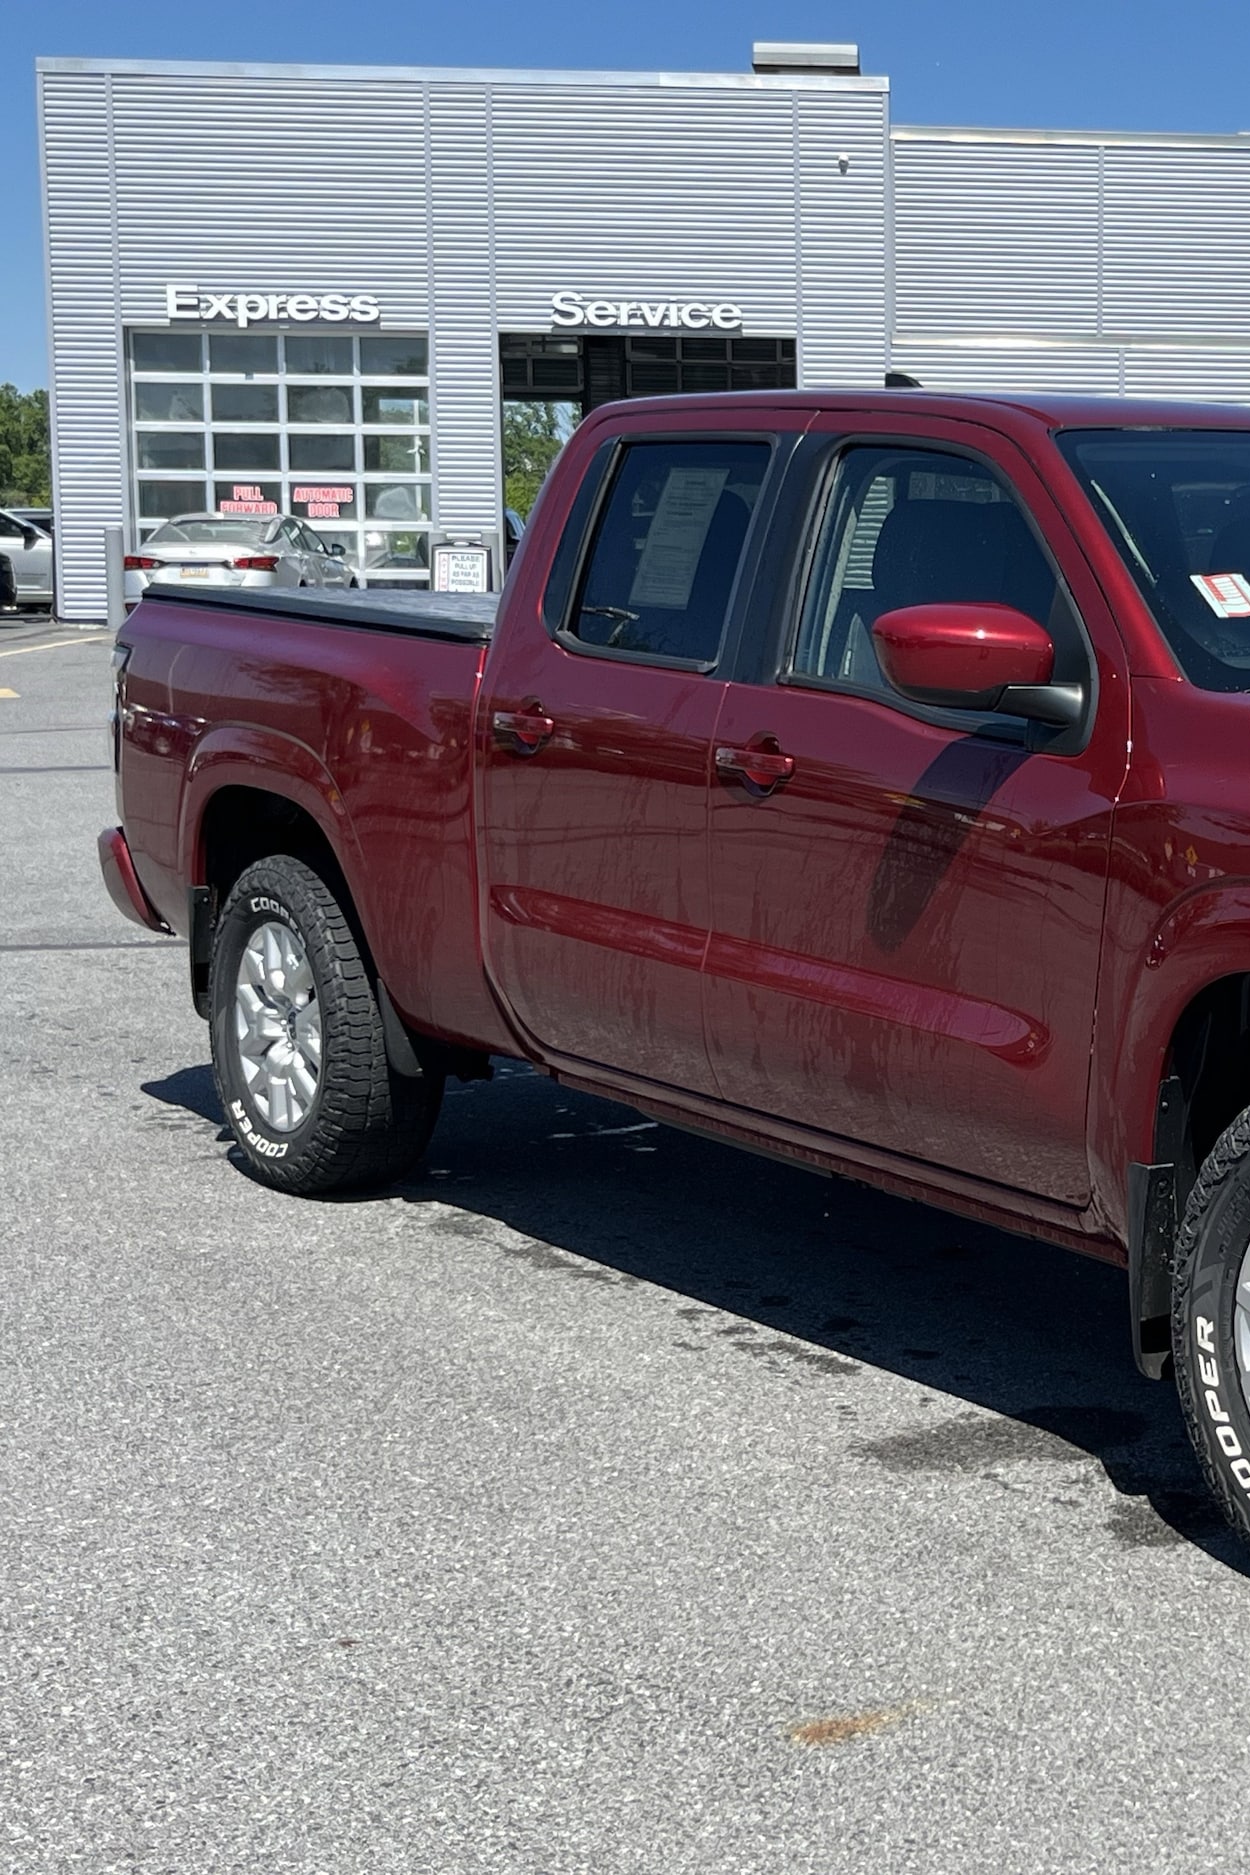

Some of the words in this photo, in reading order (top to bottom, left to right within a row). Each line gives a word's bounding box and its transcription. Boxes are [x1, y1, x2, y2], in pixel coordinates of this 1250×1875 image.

[166, 284, 380, 328] Express
[550, 291, 743, 329] Service
[233, 485, 264, 501] PULL
[293, 487, 353, 502] AUTOMATIC
[220, 501, 278, 515] FORWARD
[308, 503, 340, 517] DOOR
[231, 1098, 289, 1158] COOPER
